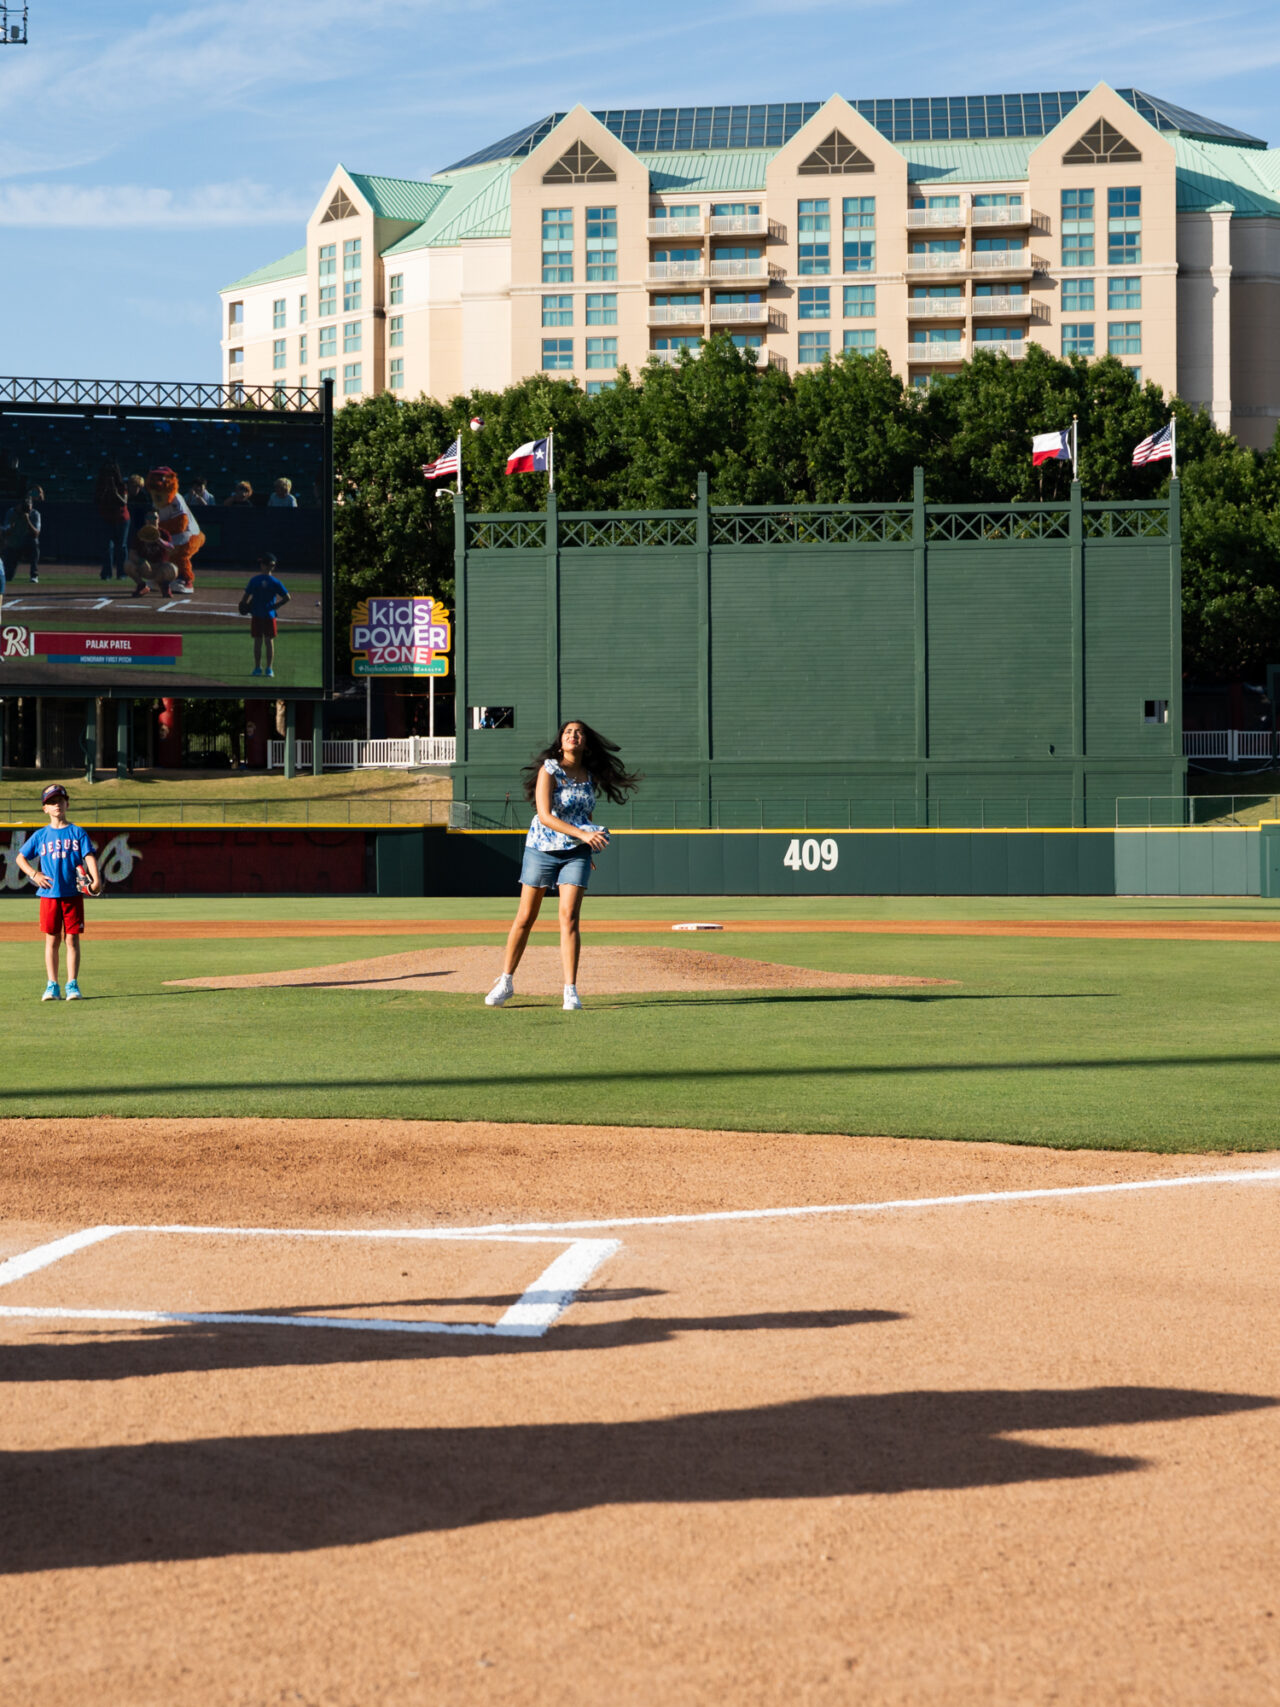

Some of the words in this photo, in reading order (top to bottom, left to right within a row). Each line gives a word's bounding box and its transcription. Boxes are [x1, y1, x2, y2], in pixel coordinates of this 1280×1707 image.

[372, 601, 434, 625] kids'
[85, 639, 109, 649] PALAK
[110, 640, 132, 650] PATEL
[354, 625, 446, 648] POWER
[371, 646, 429, 664] ZONE
[40, 839, 80, 856] JESUS
[783, 838, 839, 871] 409
